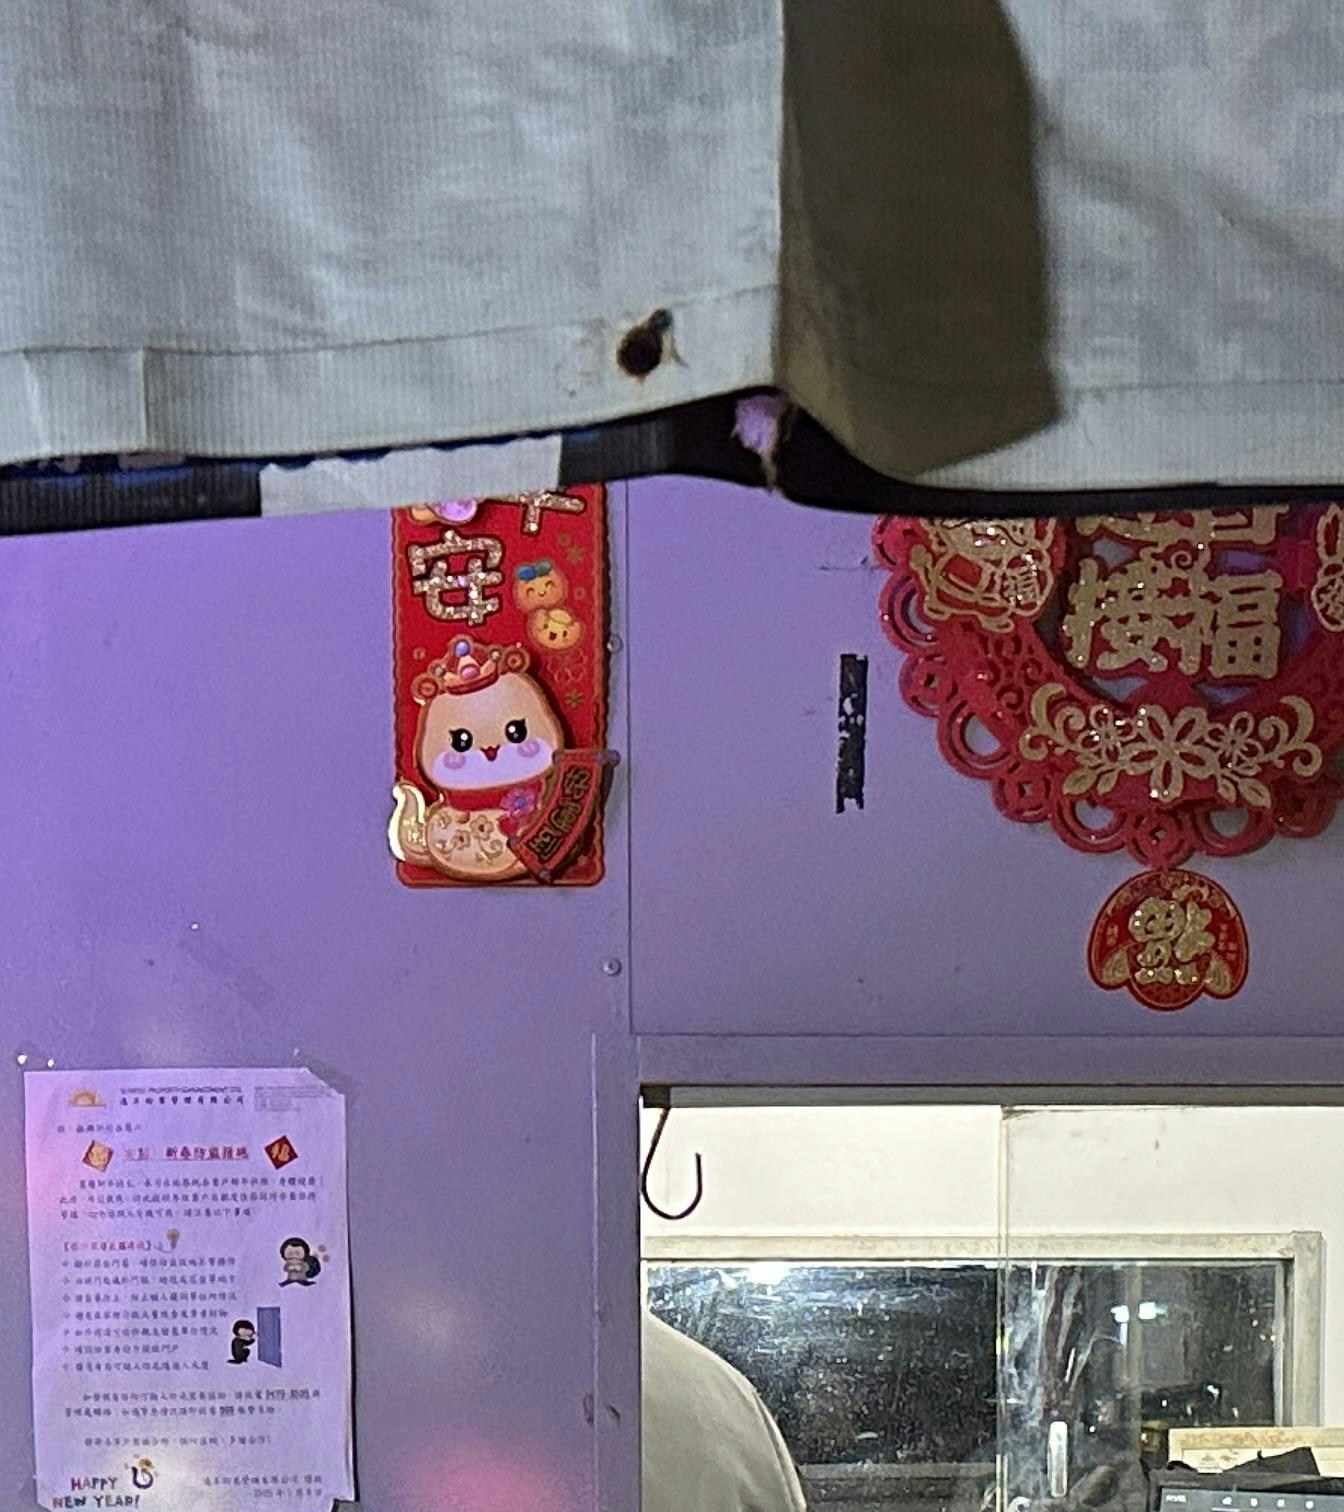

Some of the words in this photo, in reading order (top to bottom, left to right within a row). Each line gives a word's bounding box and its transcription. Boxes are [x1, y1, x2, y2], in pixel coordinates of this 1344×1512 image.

[408, 529, 504, 626] 安
[1062, 545, 1284, 679] 接福
[52, 1495, 87, 1509] NEW
[93, 1494, 141, 1510] YEAR!
[70, 1476, 118, 1492] HAPPY
